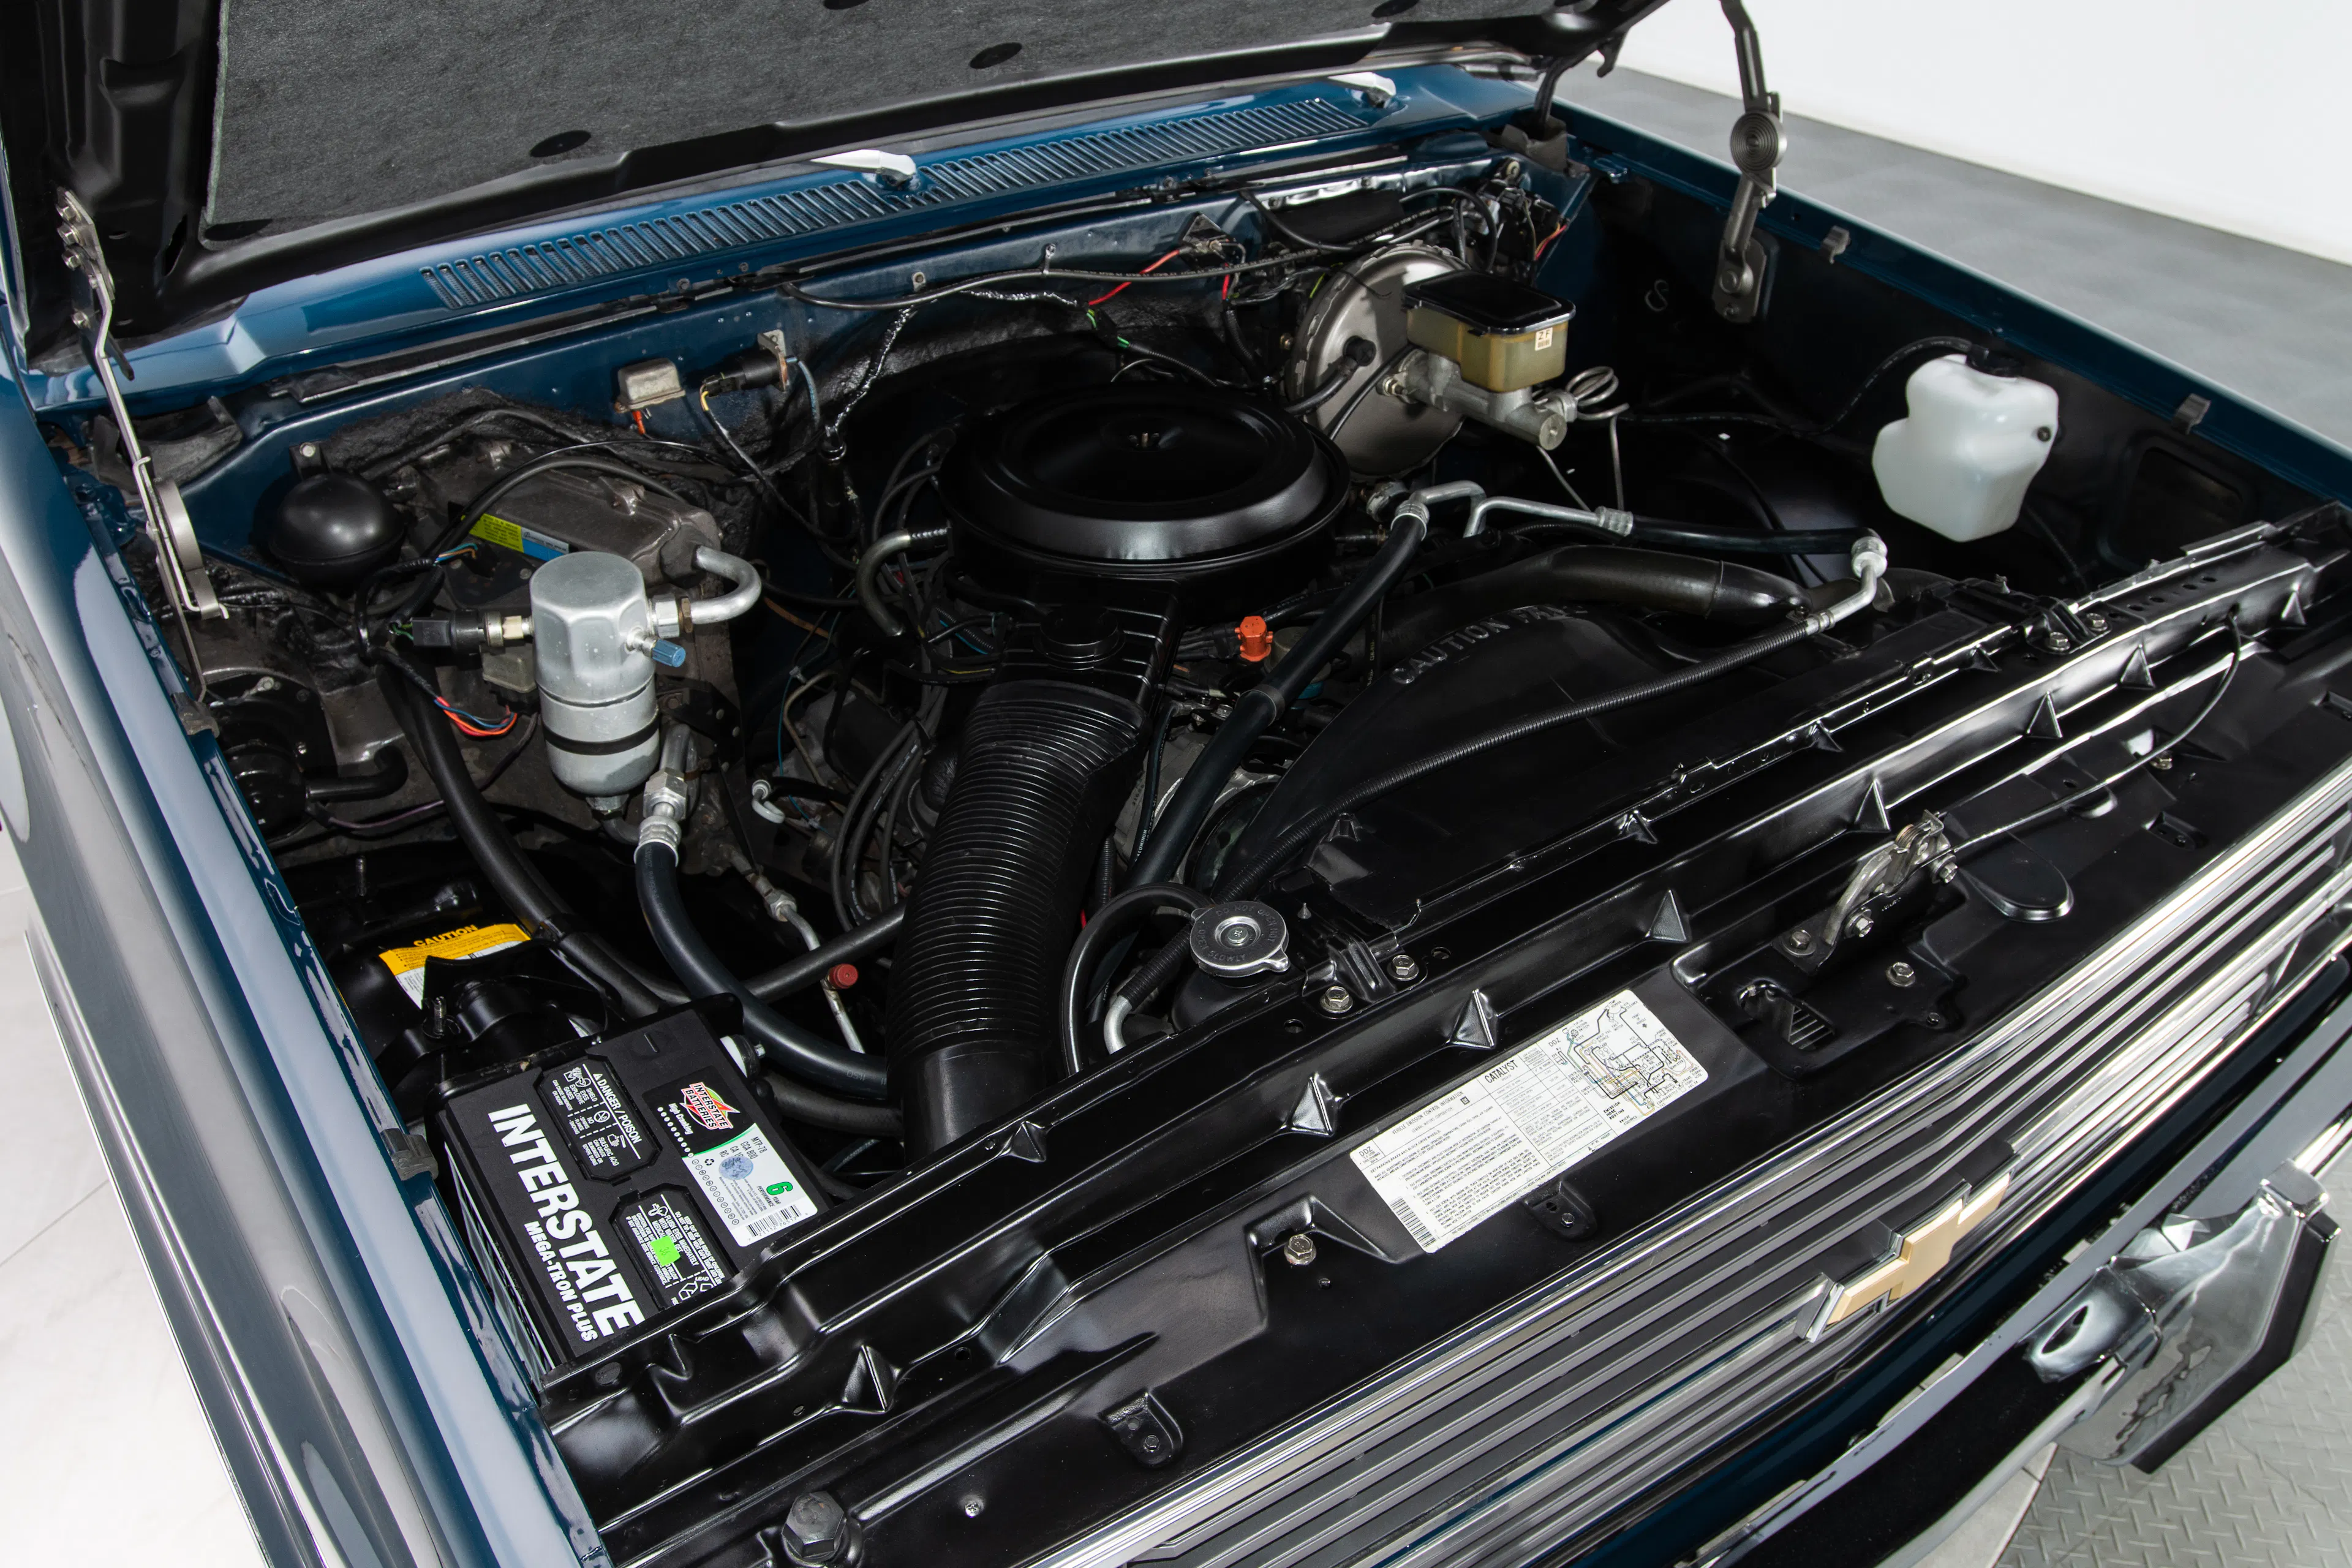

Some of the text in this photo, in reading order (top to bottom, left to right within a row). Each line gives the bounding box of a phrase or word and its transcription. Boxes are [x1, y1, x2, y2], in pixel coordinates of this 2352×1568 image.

[1390, 617, 1510, 684] CAUTION
[413, 924, 478, 946] CAUTION
[1548, 1037, 1561, 1047] DDZ
[1484, 1060, 1517, 1083] CATALYST
[556, 1085, 565, 1095] CAUSE
[563, 1086, 575, 1100] GASES
[569, 1084, 585, 1104] EXPLOSIVE
[579, 1090, 590, 1101] EYES
[586, 1087, 598, 1102] SHIELD
[560, 1095, 573, 1110] BLINDNESS
[597, 1079, 621, 1109] DANGER
[618, 1114, 642, 1144] POISON
[685, 1090, 717, 1127] BATTERIES
[694, 1085, 728, 1126] INTERSTATE
[1603, 1101, 1620, 1114] EMISSION
[668, 1102, 693, 1135] High Cranking
[1392, 1091, 1463, 1134] VEHICLE EMISSION CONTROL INFORMATION
[1423, 1117, 1435, 1126] MOTORS
[1434, 1107, 1453, 1118] CORPORATION
[1608, 1109, 1624, 1120] ROUTING
[587, 1141, 600, 1158] BLINDNESS
[597, 1146, 606, 1158] CAUSE
[598, 1137, 619, 1166] SULFURIC ACID
[740, 1140, 758, 1159] CCA 800
[751, 1136, 767, 1153] MTP-78
[1359, 1146, 1373, 1157] DDZ
[582, 1144, 598, 1166] SEVERE BURNS
[758, 1185, 775, 1207] PERFORMANCE
[766, 1181, 793, 1196] 6
[488, 1103, 646, 1337] INTERSTATE
[630, 1215, 647, 1238] INSTRUCTIONS
[658, 1217, 669, 1229] WITH
[684, 1215, 693, 1225] KEEP
[688, 1224, 698, 1233] OUT
[631, 1227, 644, 1244] AVAILABLE
[641, 1242, 649, 1253] SEEK
[645, 1251, 657, 1265] SERVICE
[636, 1212, 647, 1228] CAUTION:
[666, 1266, 679, 1280] FOLLOW
[664, 1215, 699, 1265] FLUSH EYES IMMEDIATELY
[678, 1216, 687, 1225] NOT
[687, 1231, 696, 1240] KEEP
[692, 1240, 701, 1250] VENT
[698, 1249, 707, 1259] CAPS
[703, 1258, 714, 1270] TIGHT
[709, 1269, 718, 1278] AND
[696, 1237, 705, 1246] THE
[701, 1244, 712, 1257] REACH
[711, 1261, 725, 1279] CHILDREN
[525, 1221, 598, 1341] MEGA-TRON PLUS
